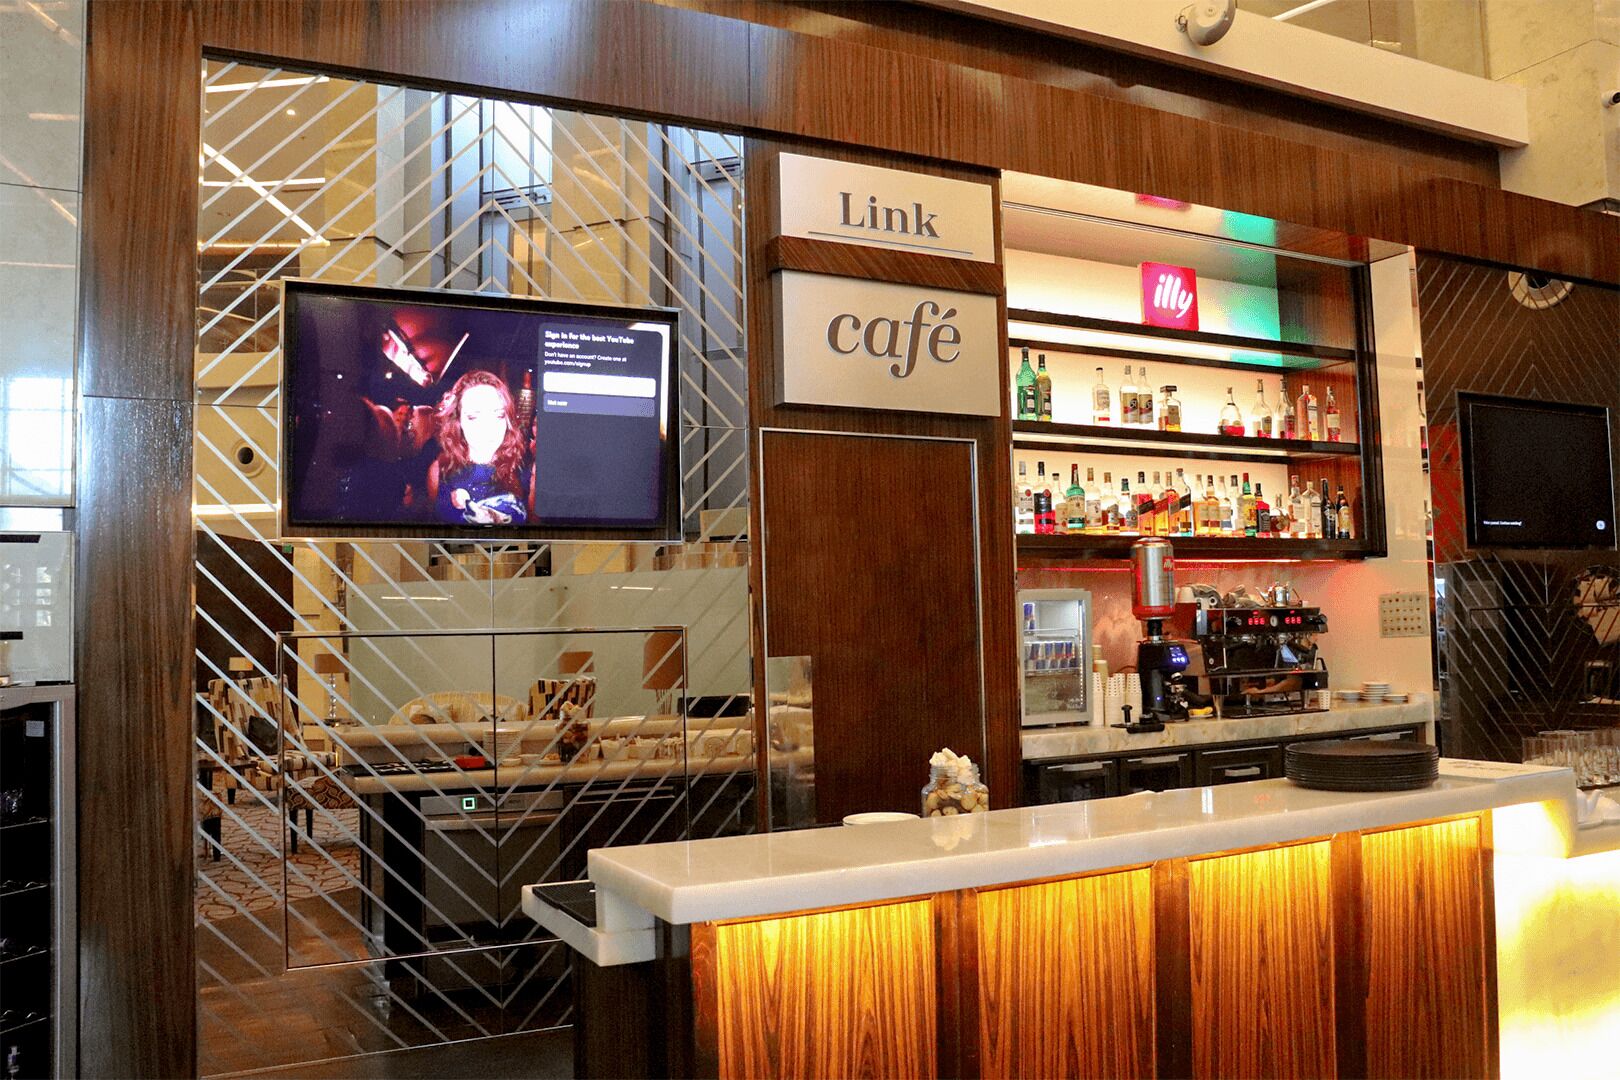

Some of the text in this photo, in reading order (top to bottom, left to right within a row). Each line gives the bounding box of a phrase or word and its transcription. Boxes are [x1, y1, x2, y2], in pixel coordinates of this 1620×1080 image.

[839, 191, 940, 238] Link
[1153, 274, 1193, 318] illy
[544, 341, 579, 349] experience
[545, 330, 559, 340] Sign
[580, 333, 590, 341] the
[592, 334, 606, 342] best
[607, 335, 634, 344] YouTube
[827, 300, 961, 378] café
